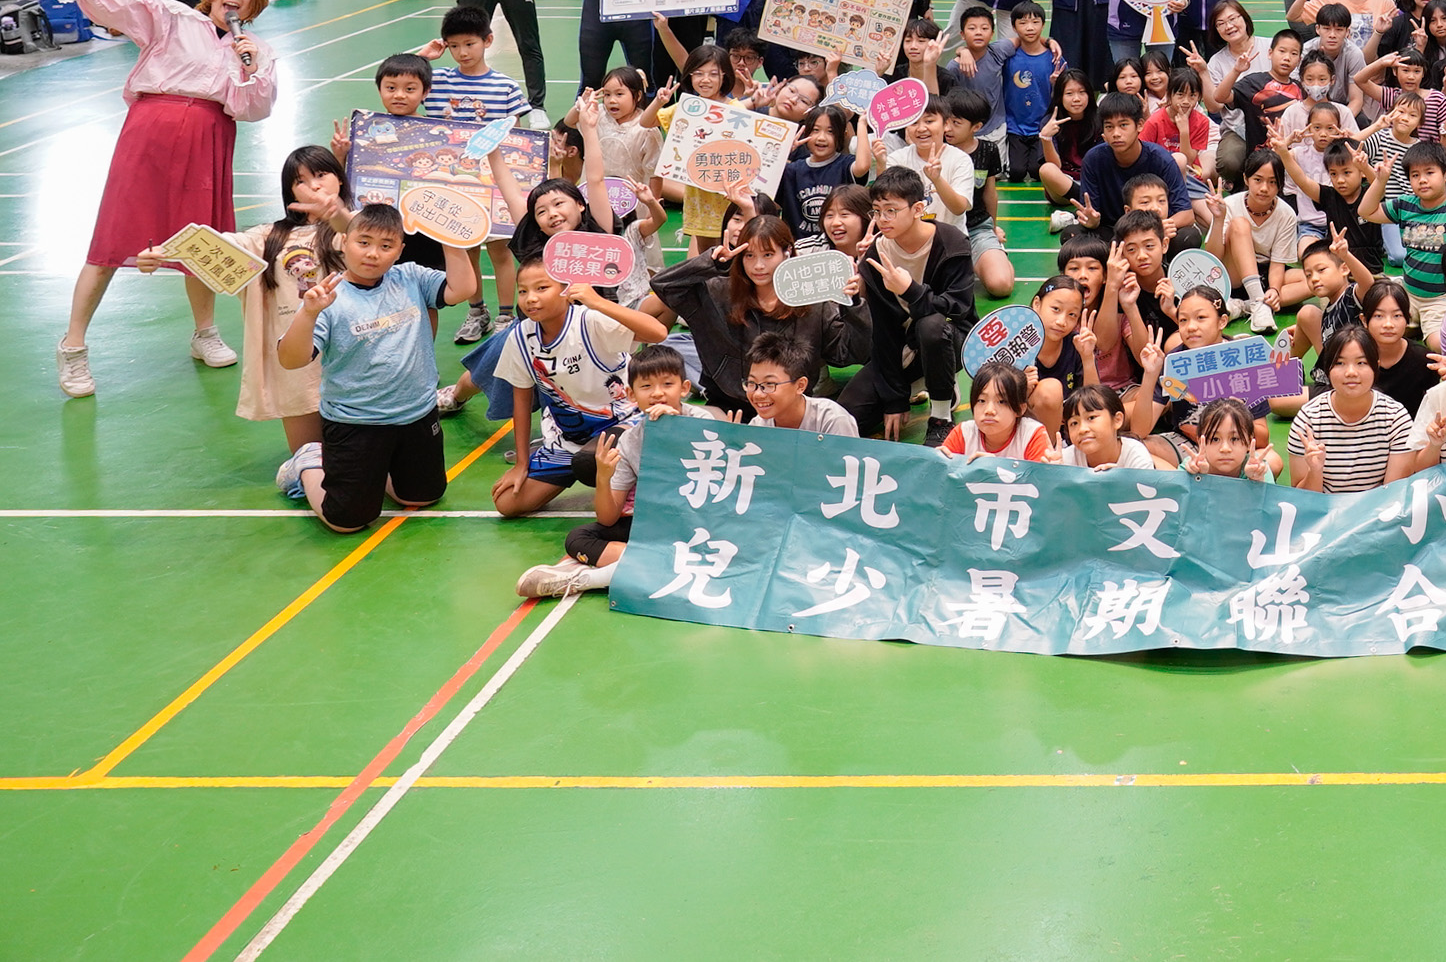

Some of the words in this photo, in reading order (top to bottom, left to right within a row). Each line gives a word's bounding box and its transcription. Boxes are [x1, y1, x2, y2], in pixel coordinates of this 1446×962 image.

[876, 88, 918, 113] 外流一秒
[880, 98, 923, 122] 傷害一生
[695, 151, 753, 168] 勇敢求助
[698, 168, 741, 183] 不丟臉
[422, 189, 463, 218] 守護從
[410, 200, 474, 240] 說出口開始
[200, 237, 248, 280] 一次傳送
[554, 241, 622, 264] 點擊之前
[186, 243, 238, 288] 終身風險
[551, 258, 601, 277] 想後果
[782, 258, 844, 283] AI也可能
[800, 275, 846, 296] 傷害你
[355, 320, 380, 333] DENIM
[982, 323, 1041, 366] 圖報警
[567, 363, 580, 375] 23
[1171, 342, 1267, 376] 守護家庭
[1203, 366, 1280, 399] 小衛星
